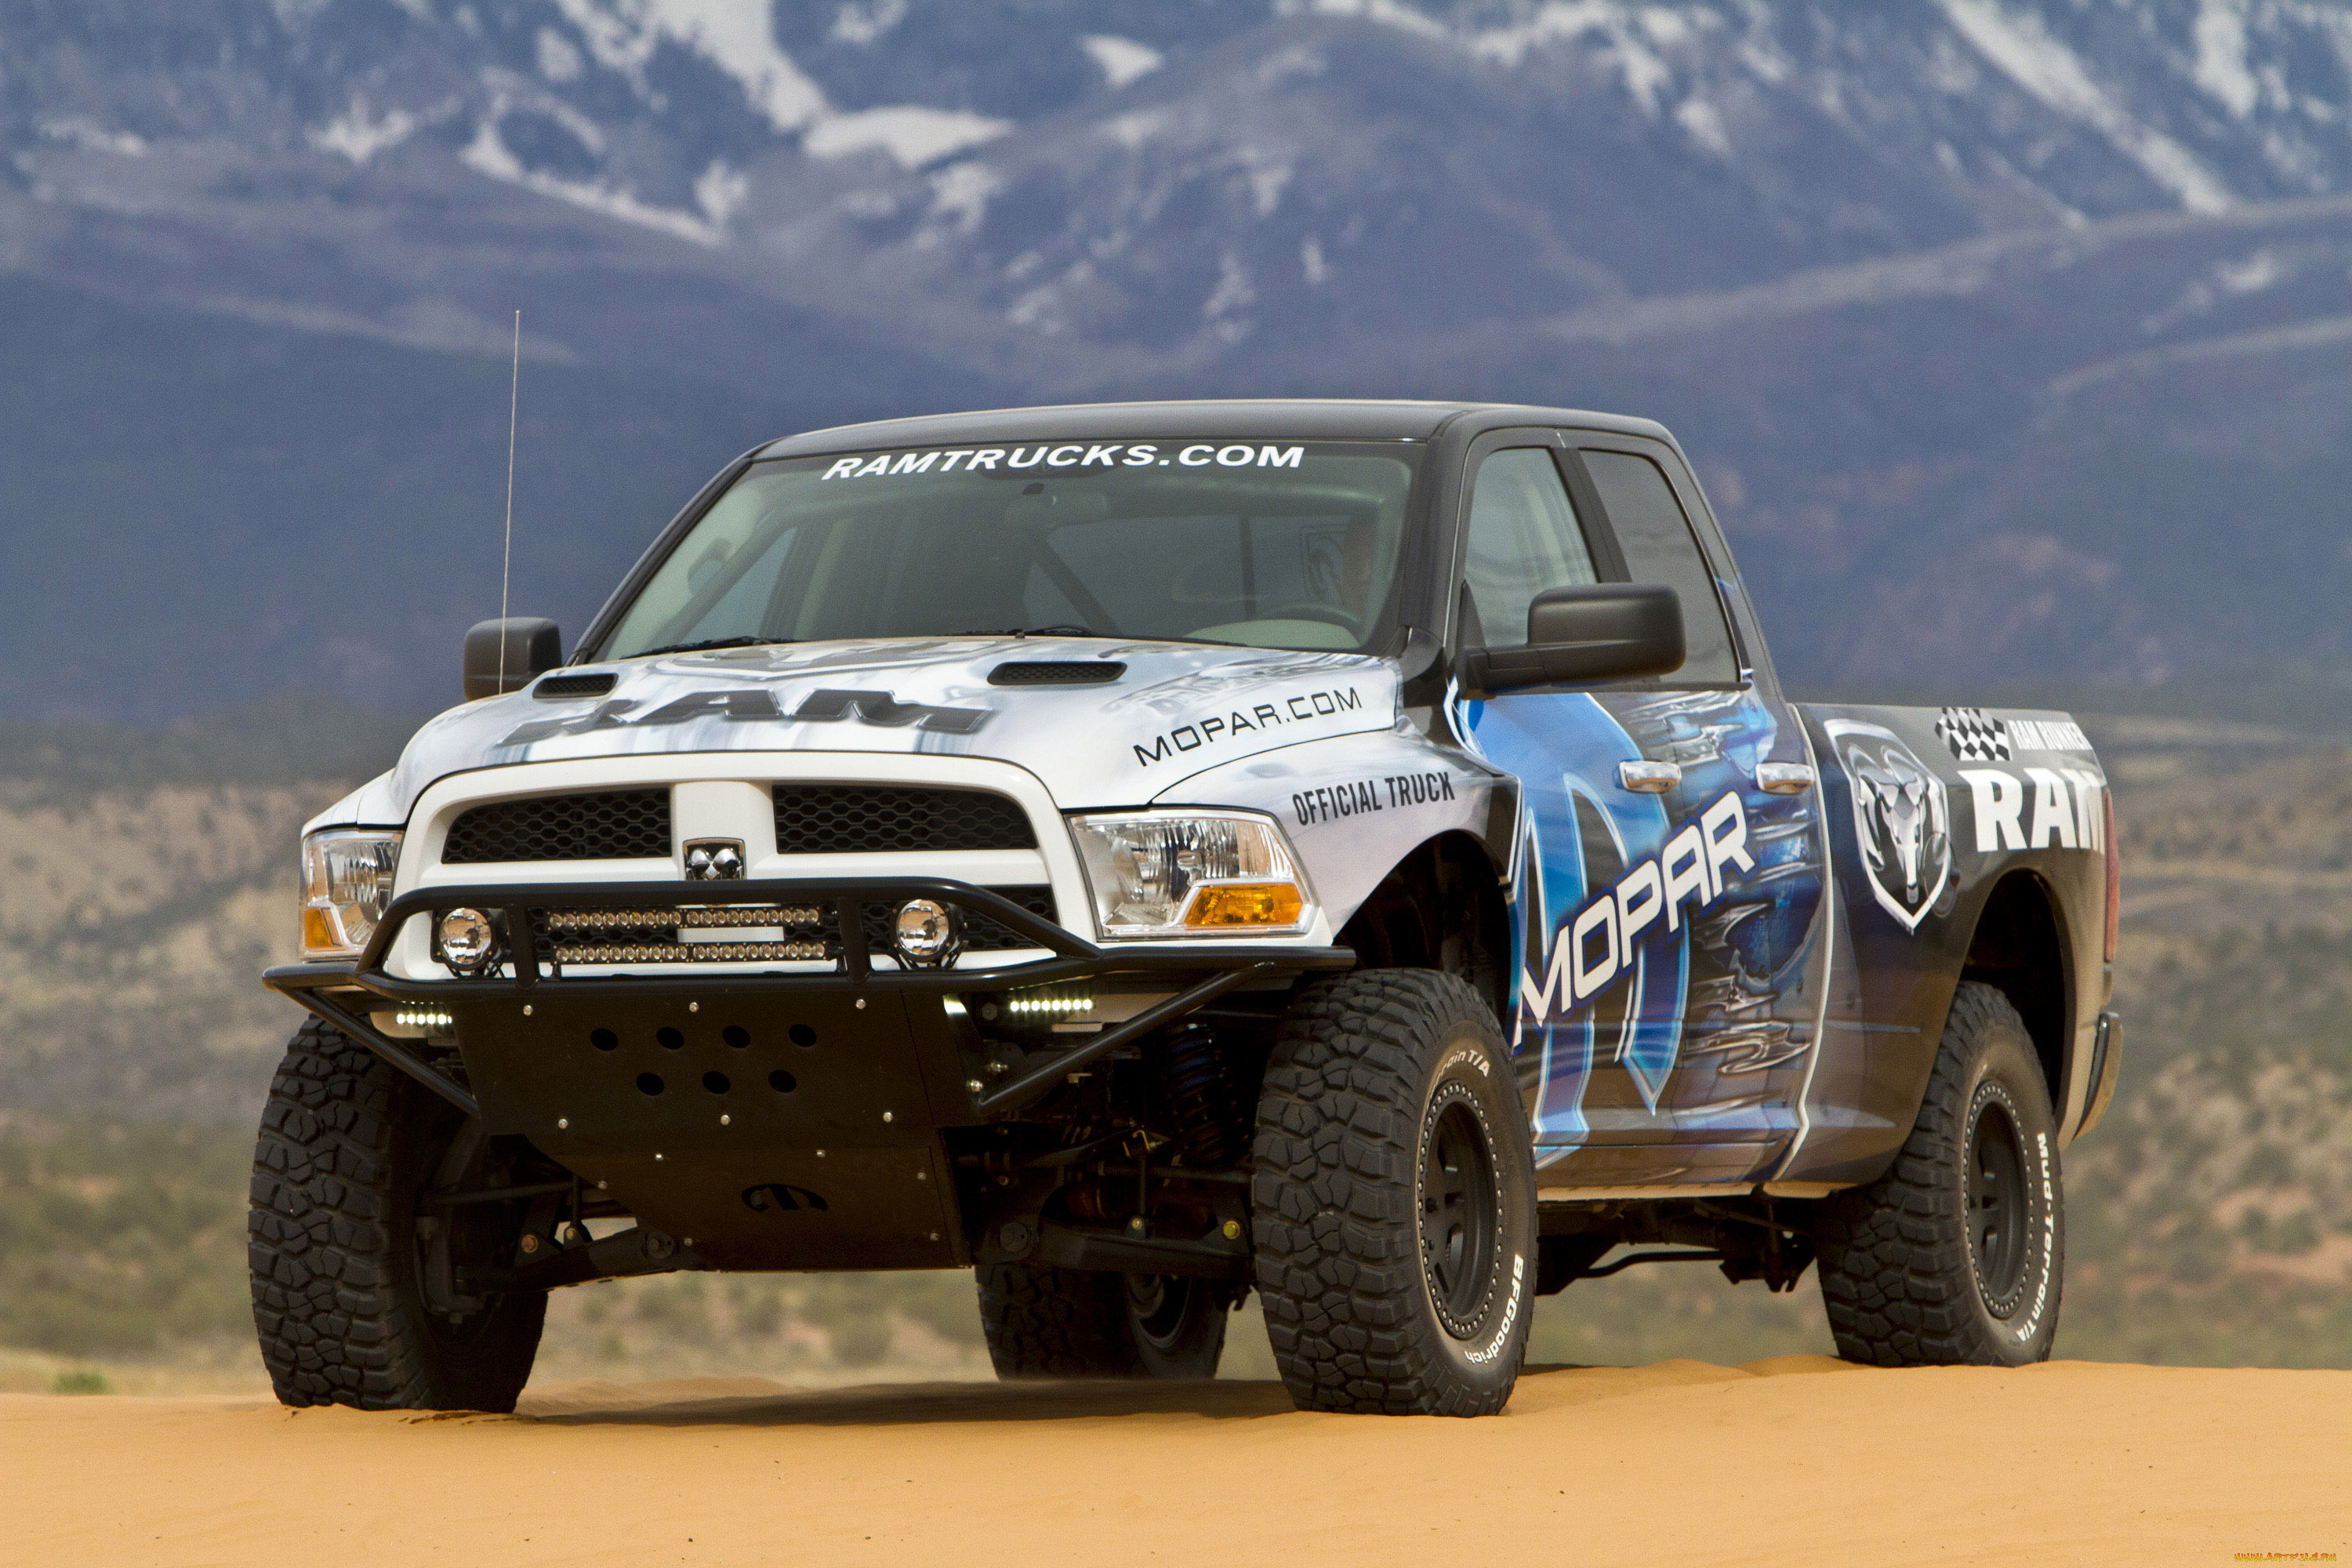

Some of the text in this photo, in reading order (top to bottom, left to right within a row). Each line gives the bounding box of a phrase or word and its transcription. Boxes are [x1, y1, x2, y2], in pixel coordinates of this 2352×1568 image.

[821, 445, 1305, 481] RAMTRUCKS.COM
[1133, 687, 1363, 768] MOPAR.COM
[2007, 720, 2095, 751] RAM RUNNER
[1292, 771, 1456, 826] OFFICIAL TRUCK
[1957, 767, 2106, 856] RAM
[1512, 790, 1756, 1049] MOPAR
[1464, 1254, 1524, 1364] BFGoodrich
